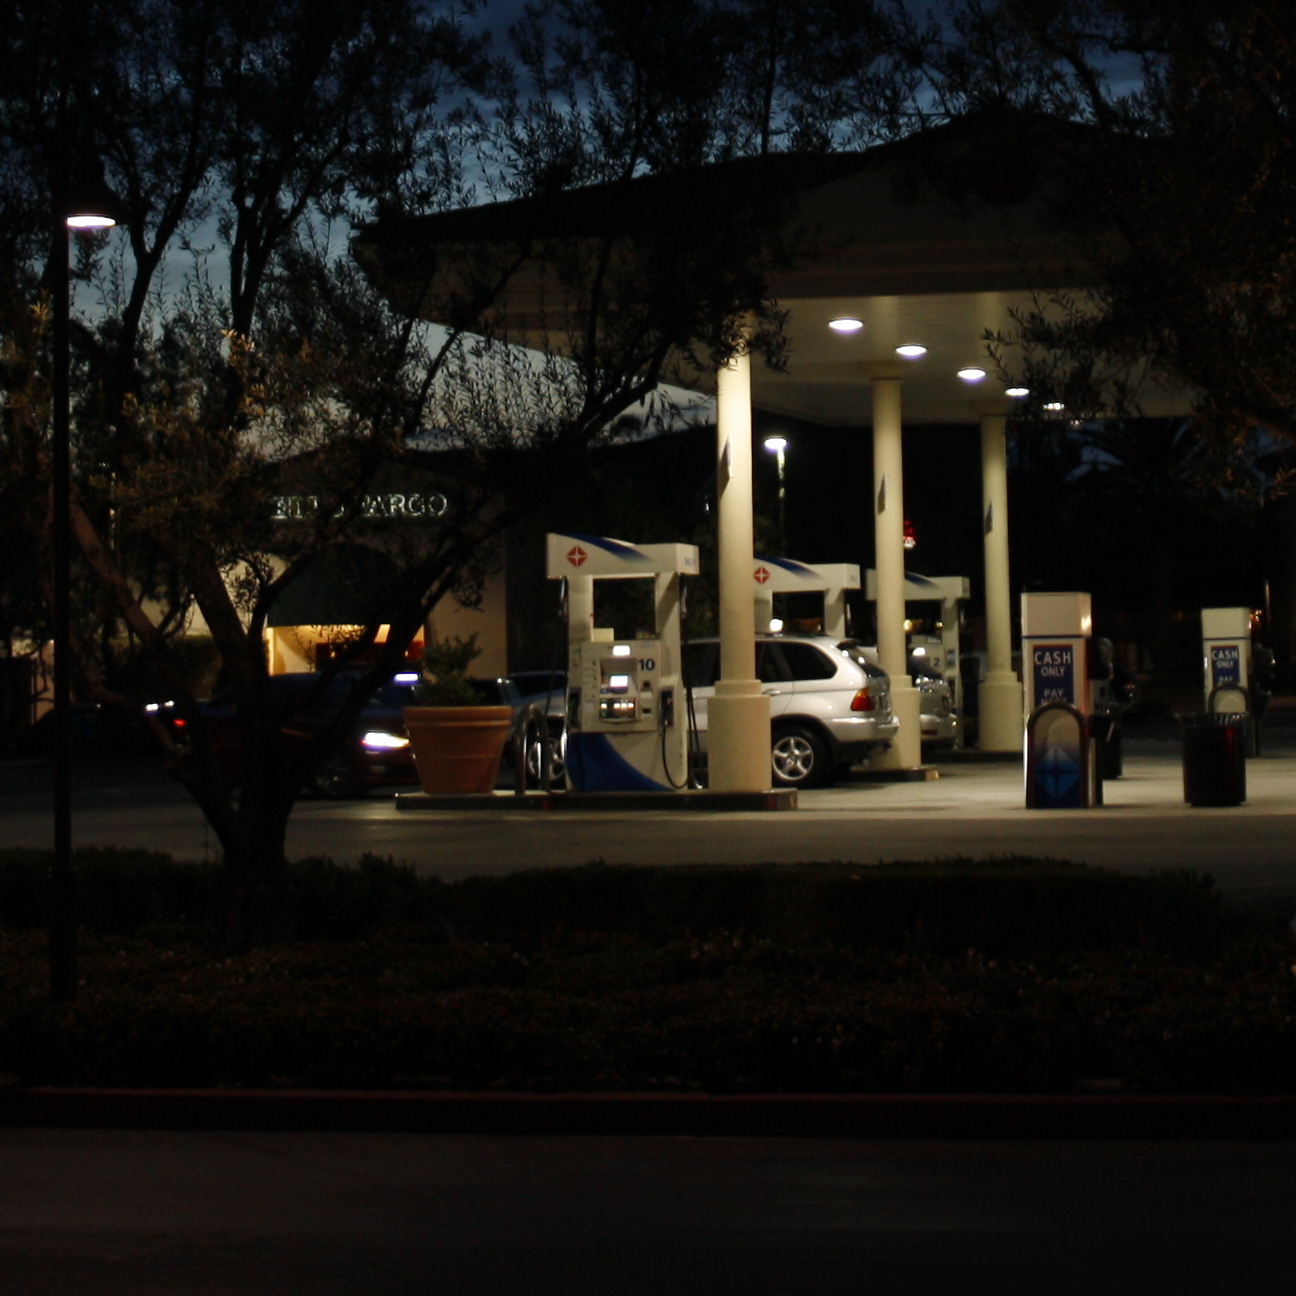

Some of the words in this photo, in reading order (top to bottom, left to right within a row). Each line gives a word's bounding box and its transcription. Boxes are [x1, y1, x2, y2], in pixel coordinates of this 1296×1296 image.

[1034, 650, 1071, 665] CASH
[1212, 649, 1238, 660] CASH
[638, 658, 656, 671] 10
[1041, 666, 1066, 677] ONLY
[1044, 688, 1064, 698] PAY
